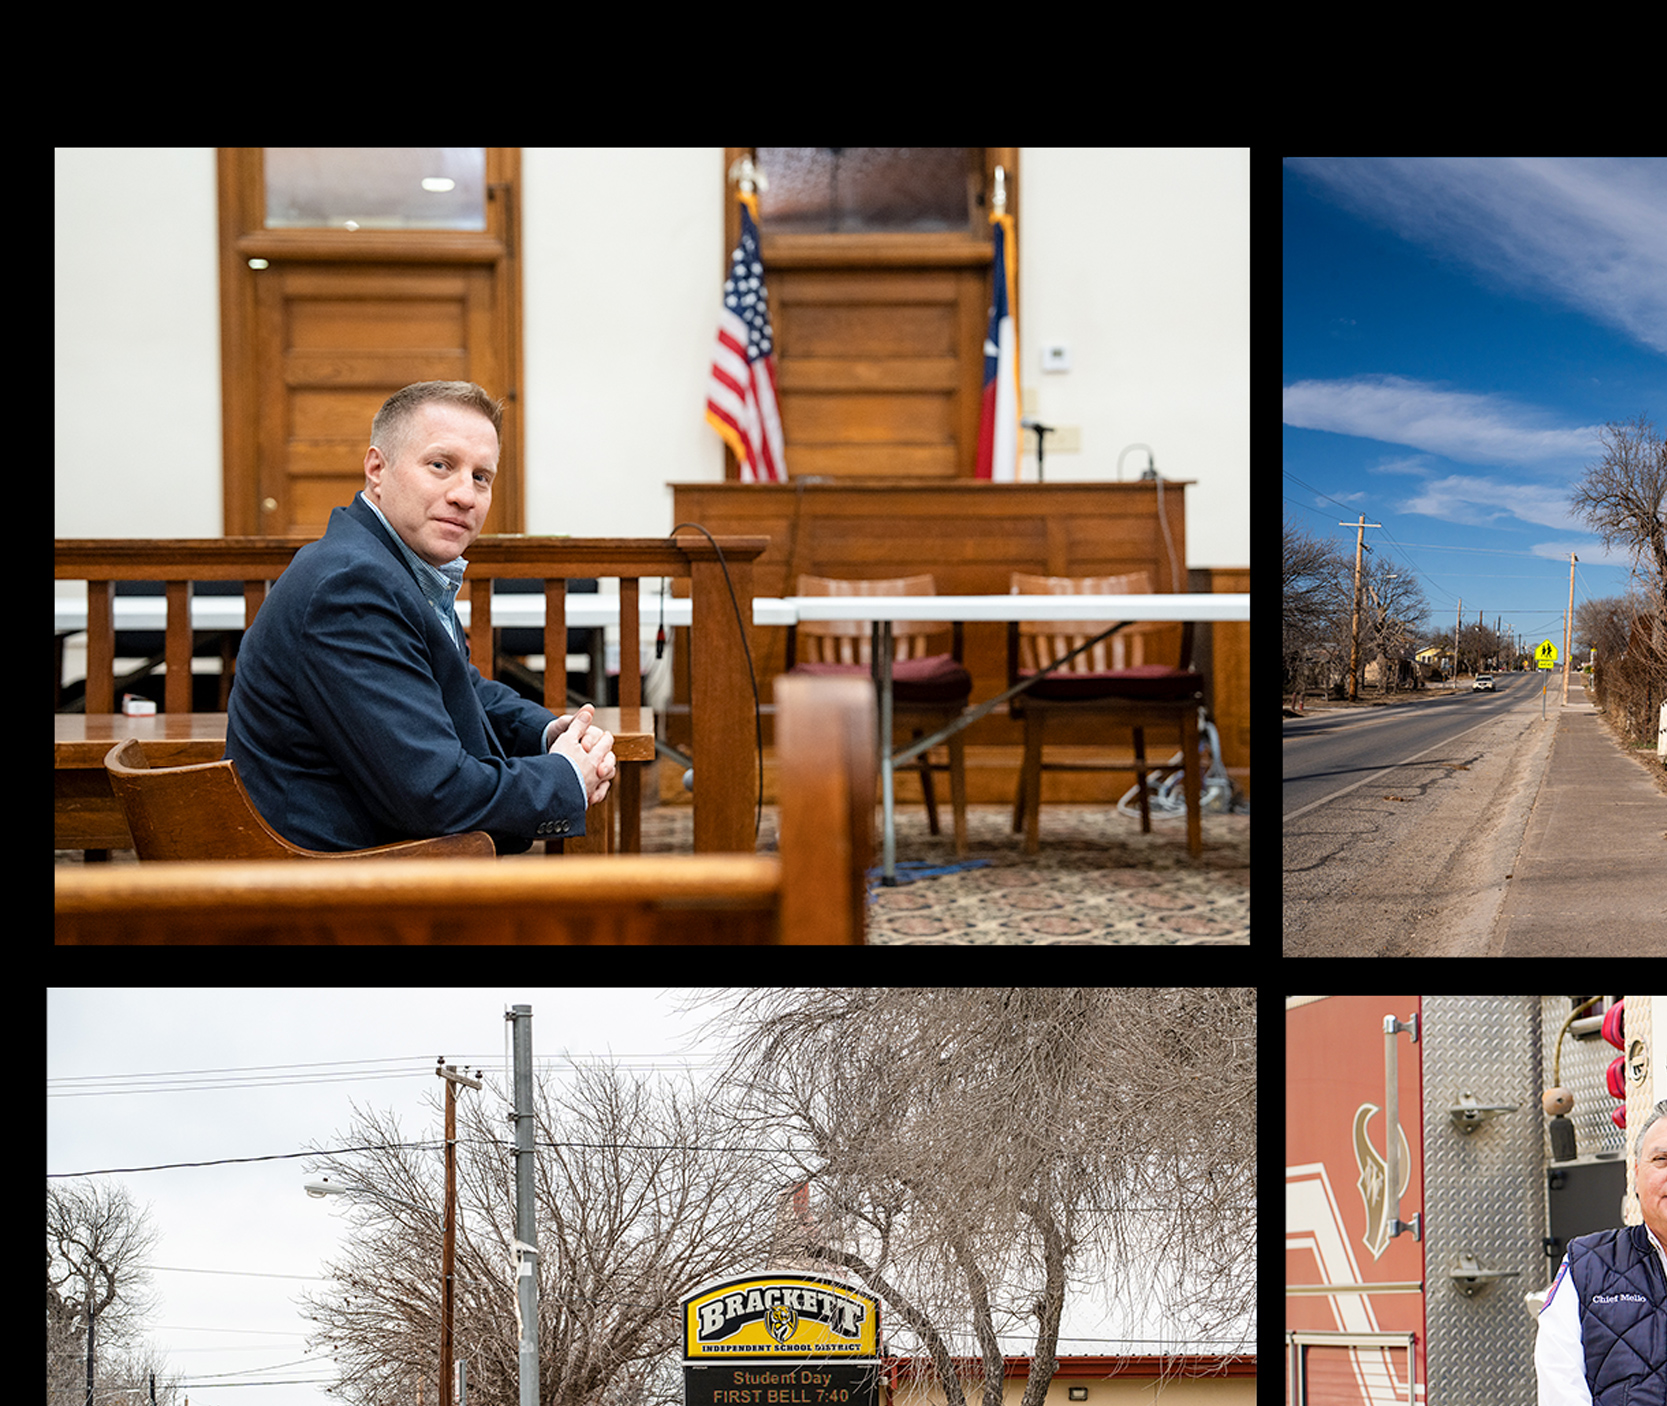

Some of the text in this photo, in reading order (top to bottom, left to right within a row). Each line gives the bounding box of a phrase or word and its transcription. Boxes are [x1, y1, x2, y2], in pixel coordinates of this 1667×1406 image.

[1592, 1293, 1647, 1304] Chief Mello
[700, 1287, 864, 1339] BRACKETT
[702, 1343, 861, 1353] INDEPENDENT SCHOOL DISTRICT
[733, 1371, 832, 1387] Student Day
[713, 1389, 849, 1403] FIRST BELL 7:40
